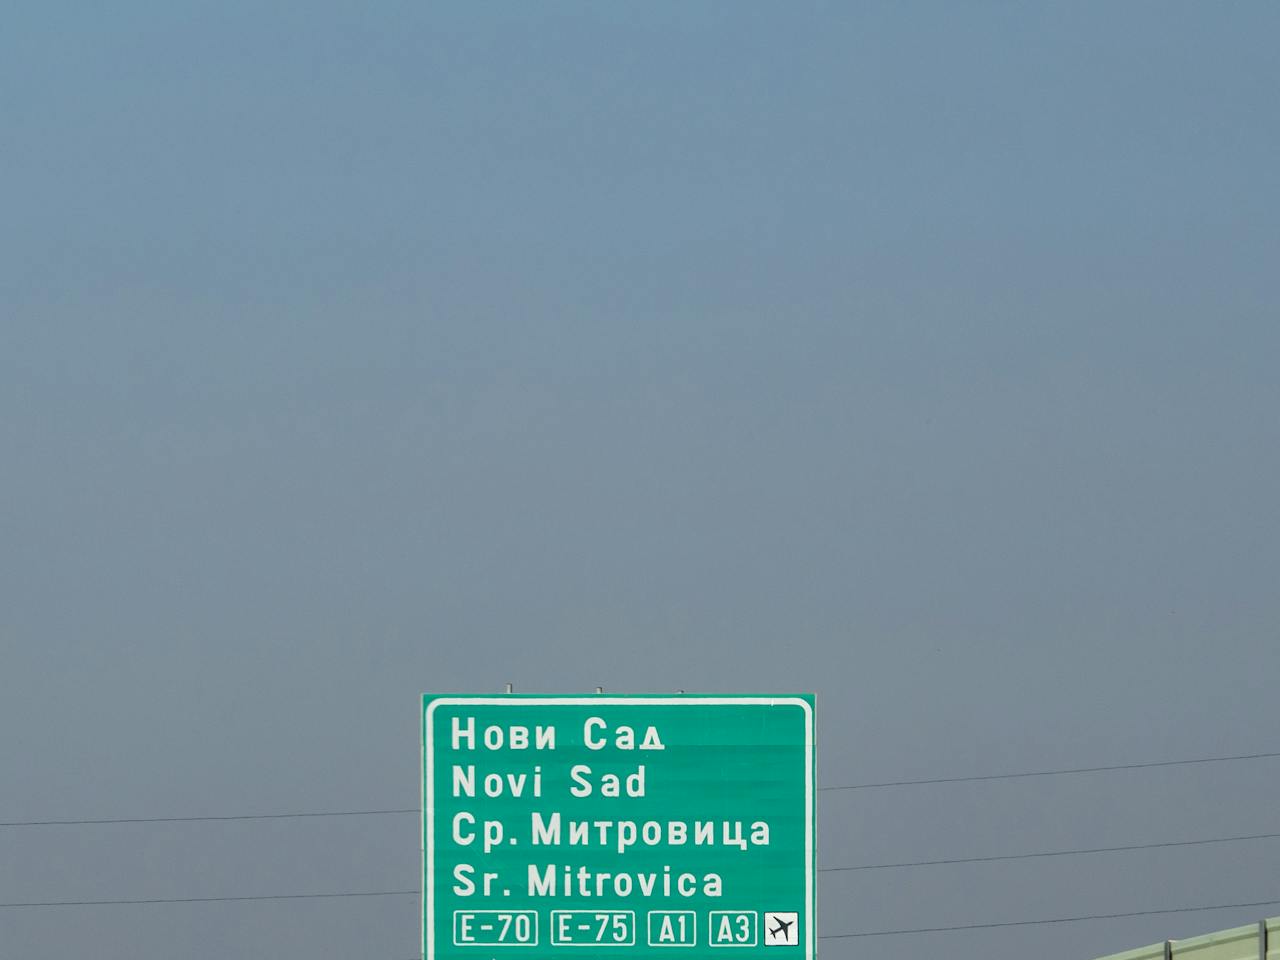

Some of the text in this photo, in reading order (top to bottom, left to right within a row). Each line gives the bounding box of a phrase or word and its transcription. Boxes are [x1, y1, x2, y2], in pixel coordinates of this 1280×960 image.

[451, 716, 666, 751] Нови Сад
[452, 764, 646, 798] Novi Sad
[452, 811, 771, 854] Ср. Митровица
[453, 863, 723, 897] Sr. Mitrovica
[461, 914, 531, 942] E-70
[558, 914, 629, 942] E-75
[659, 915, 687, 943] A1
[717, 915, 750, 943] A3
